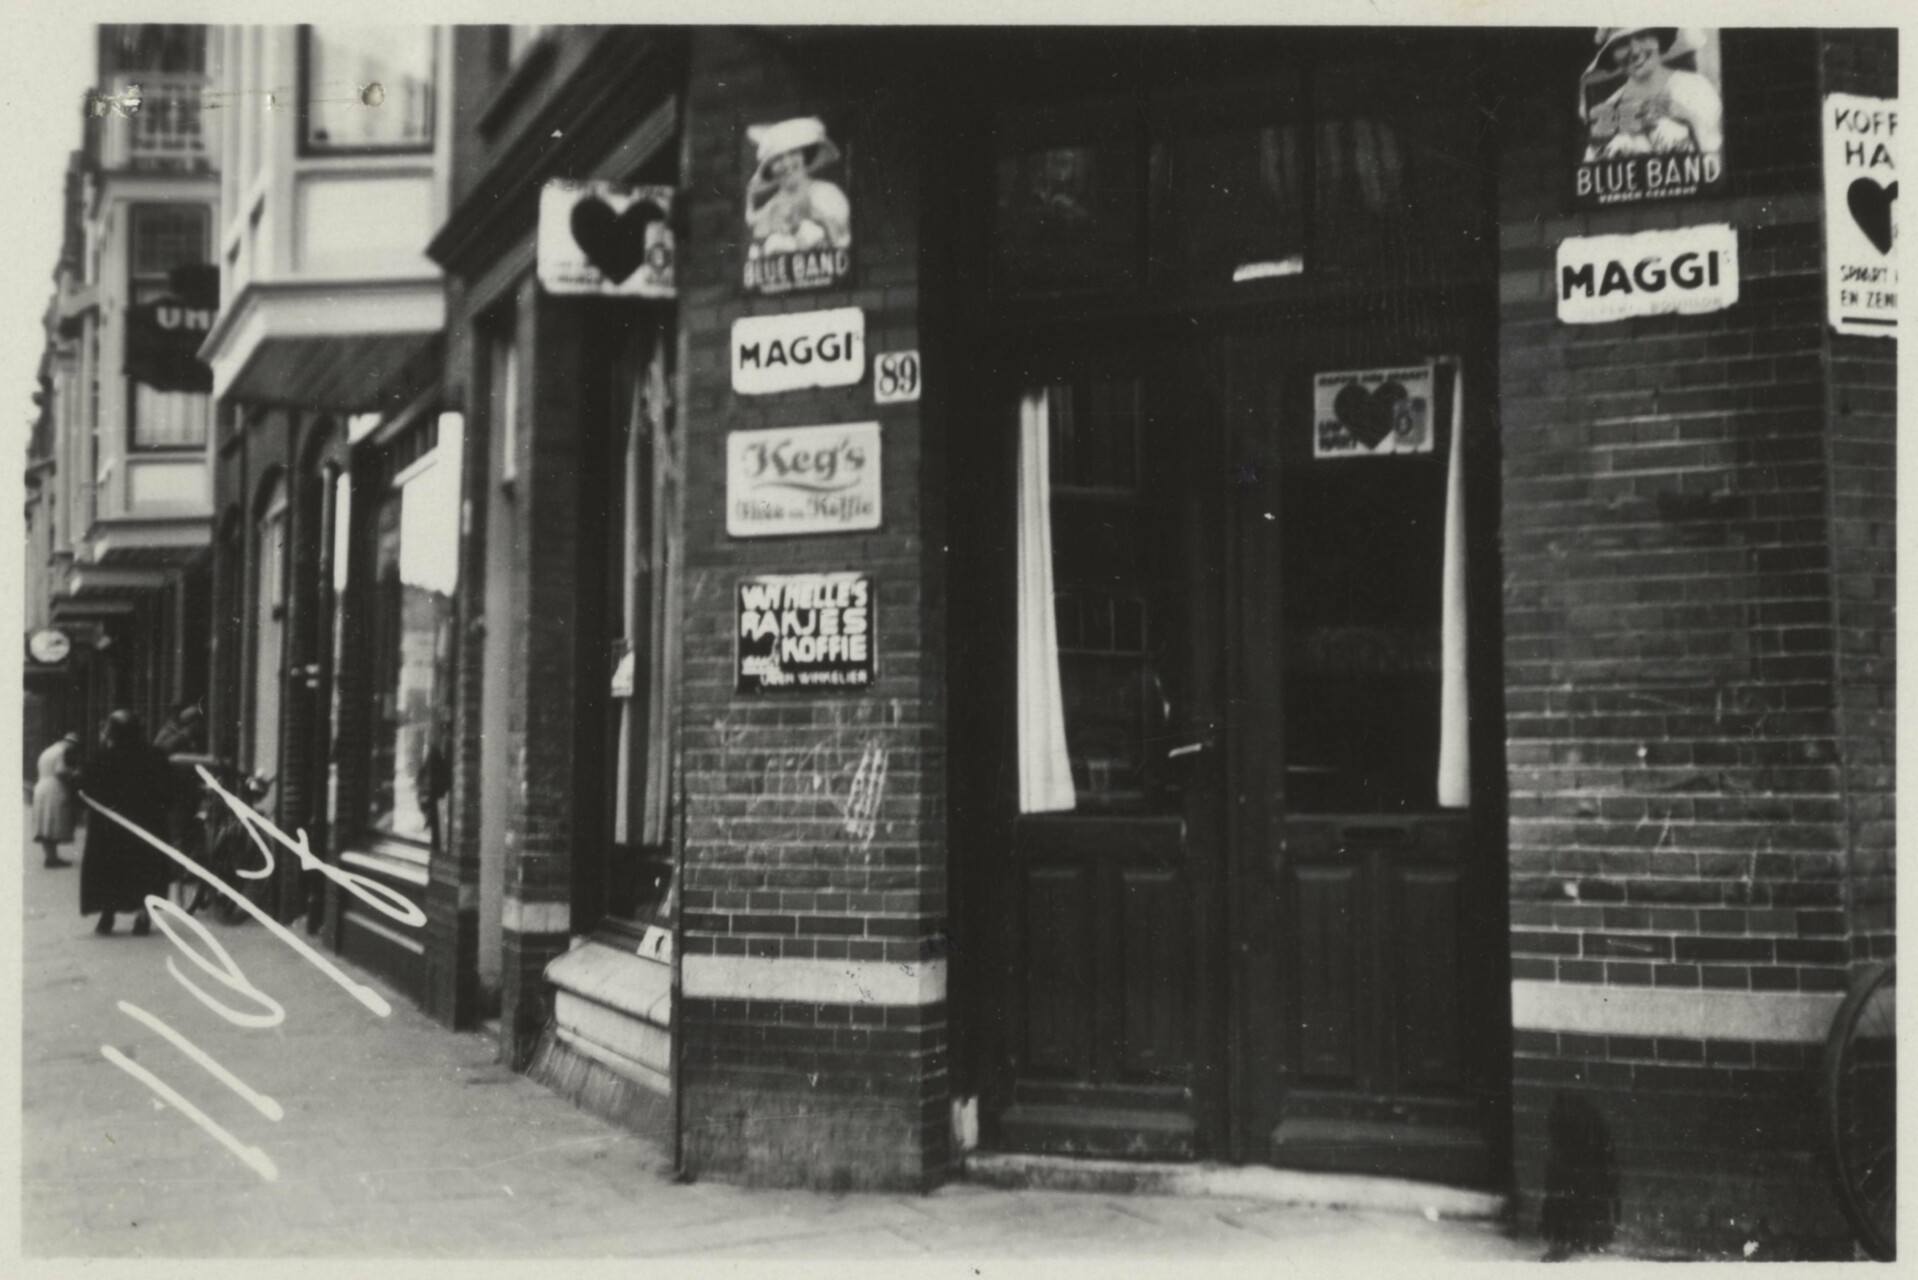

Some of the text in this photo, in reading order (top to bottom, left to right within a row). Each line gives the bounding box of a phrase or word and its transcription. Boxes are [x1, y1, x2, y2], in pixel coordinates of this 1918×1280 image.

[1577, 160, 1638, 196] BLUE
[1646, 154, 1721, 189] BAND
[743, 256, 787, 289] BLUE
[792, 250, 849, 279] BAND
[1562, 250, 1720, 301] MAGGI
[739, 332, 853, 370] MAGGI
[879, 353, 918, 397] 89
[741, 437, 866, 481] Keg's
[741, 607, 868, 641] PAKJES
[781, 634, 868, 663] KOFFIE
